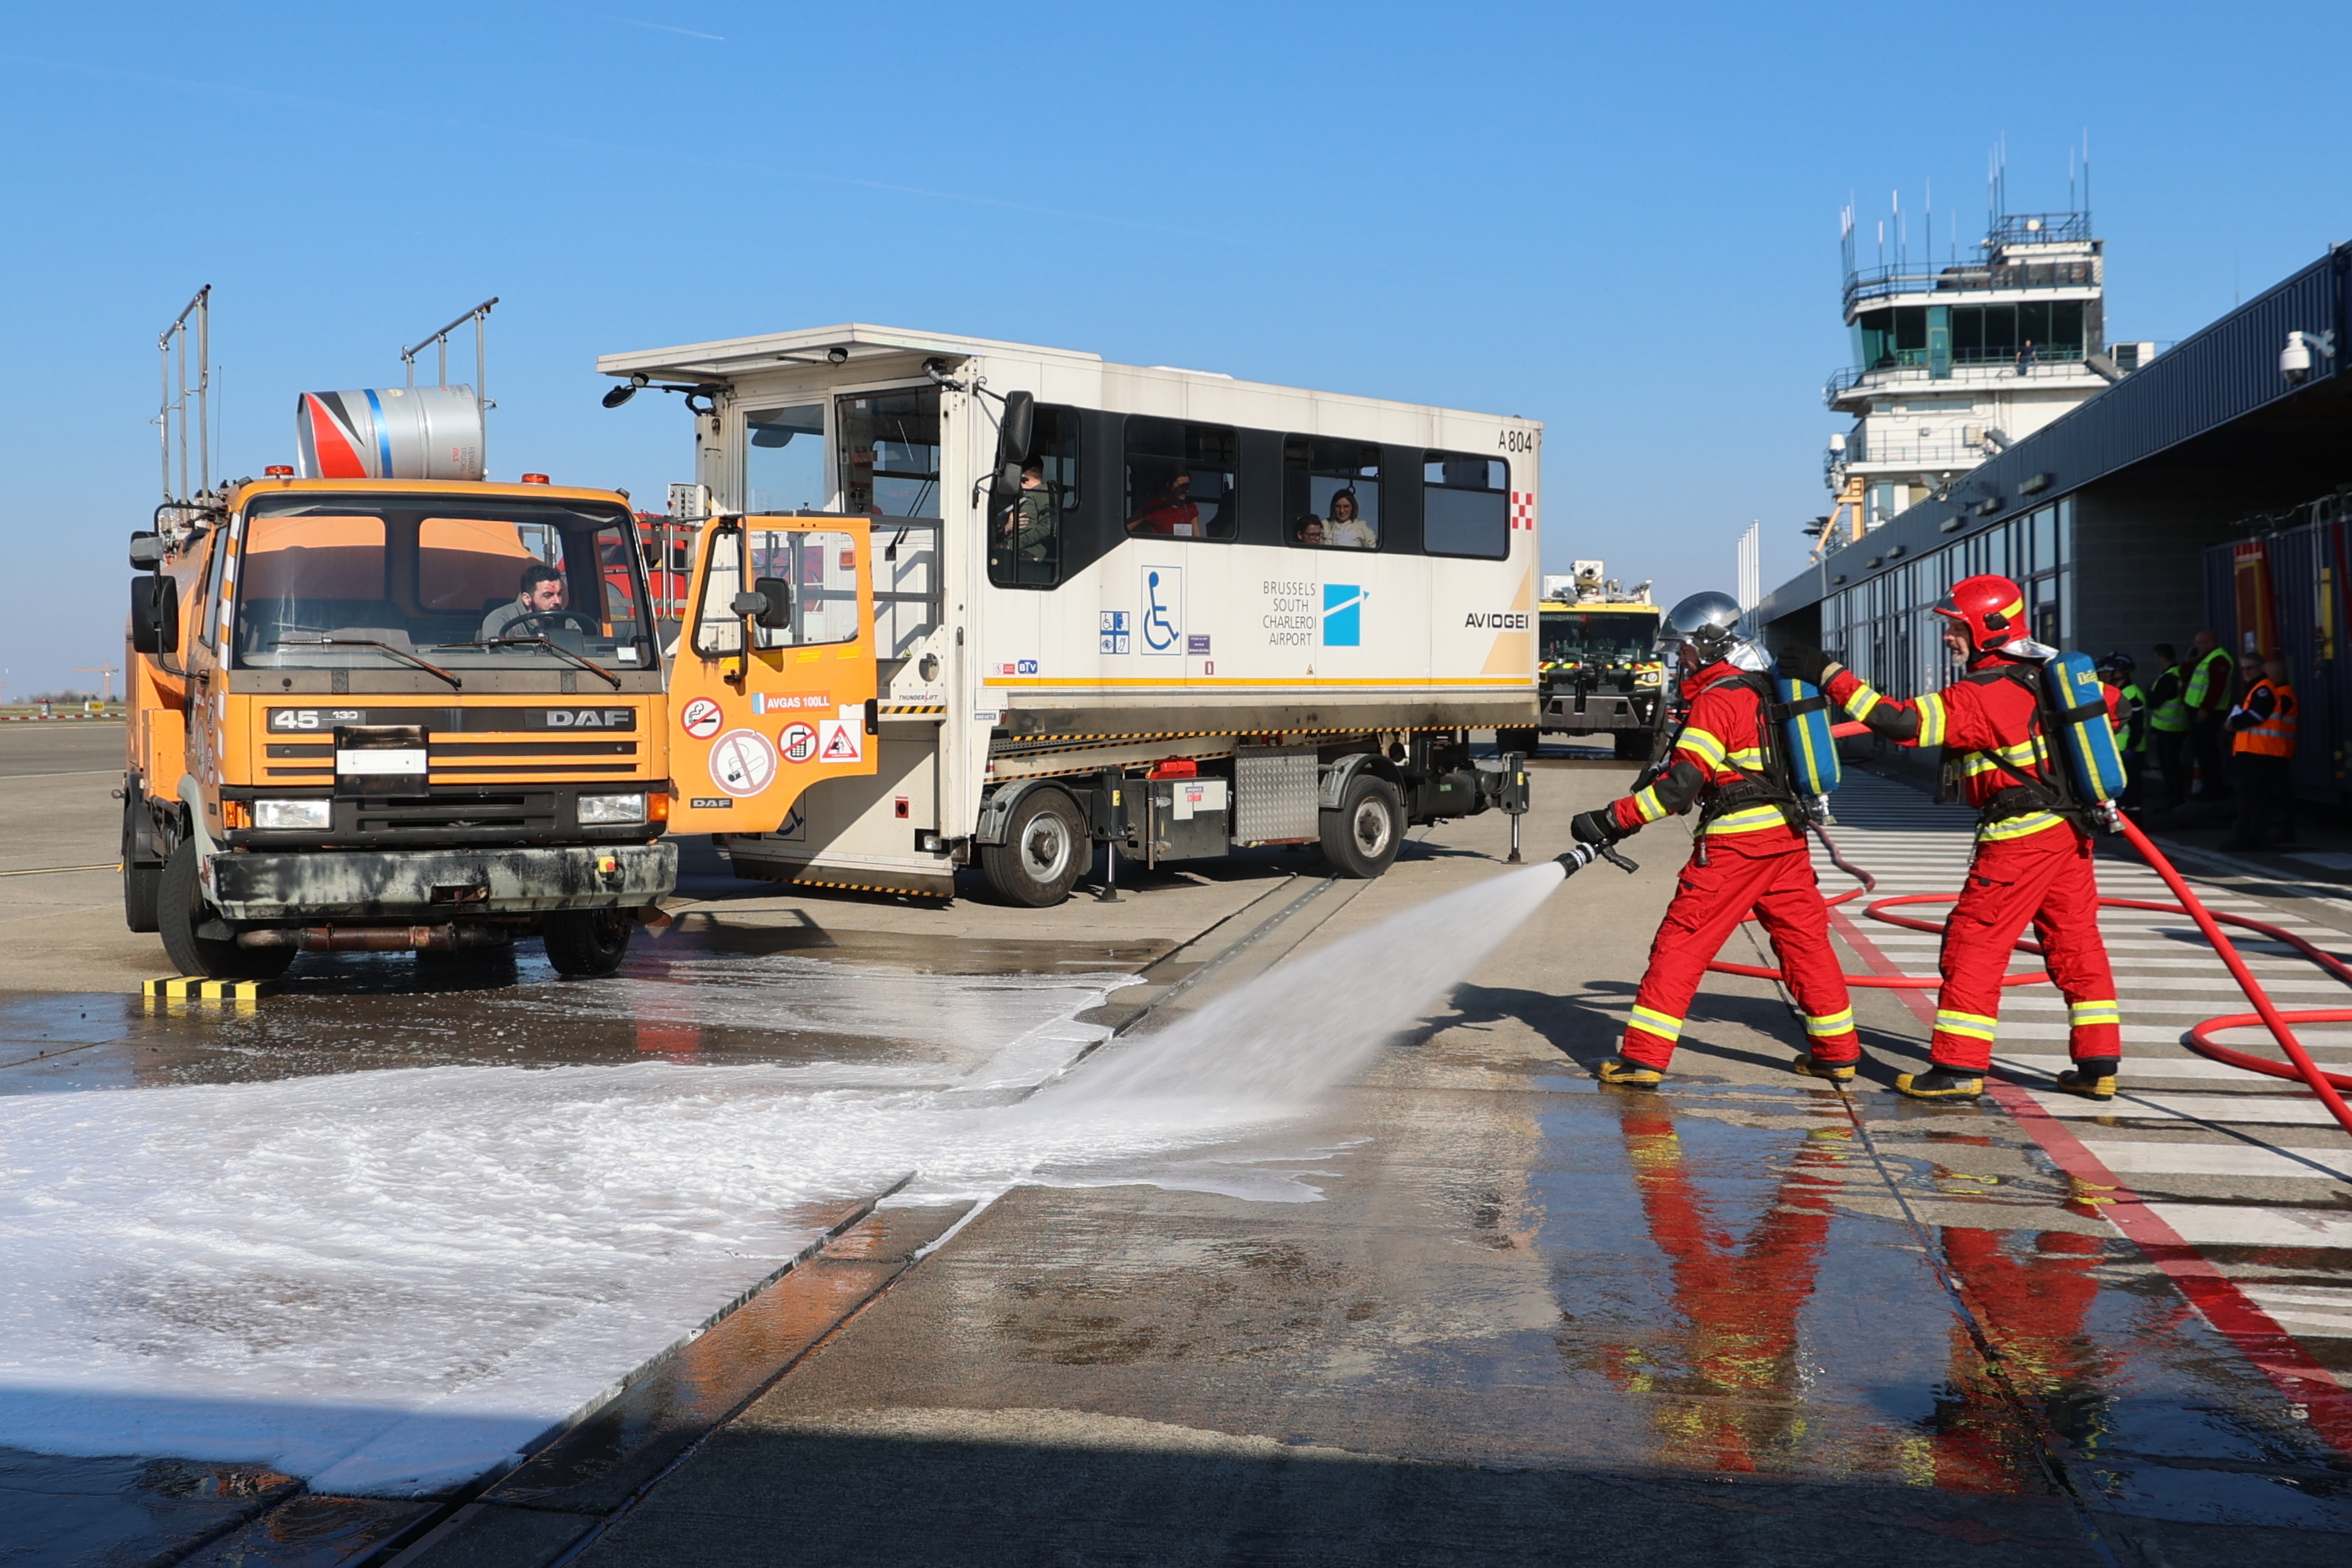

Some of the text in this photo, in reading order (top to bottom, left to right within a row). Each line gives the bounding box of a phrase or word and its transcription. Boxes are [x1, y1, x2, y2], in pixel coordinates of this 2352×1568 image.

[1263, 581, 1315, 596] BRUSSELS
[1273, 598, 1308, 612] SOUTH
[1262, 615, 1316, 629] CHARLEROI
[1465, 612, 1529, 629] AVIOGEI
[1269, 632, 1313, 646] AIRPORT
[1019, 661, 1037, 672] BTV
[767, 696, 830, 709] AVGAS 100LL
[274, 710, 358, 729] 45 130
[546, 710, 629, 726] DAF
